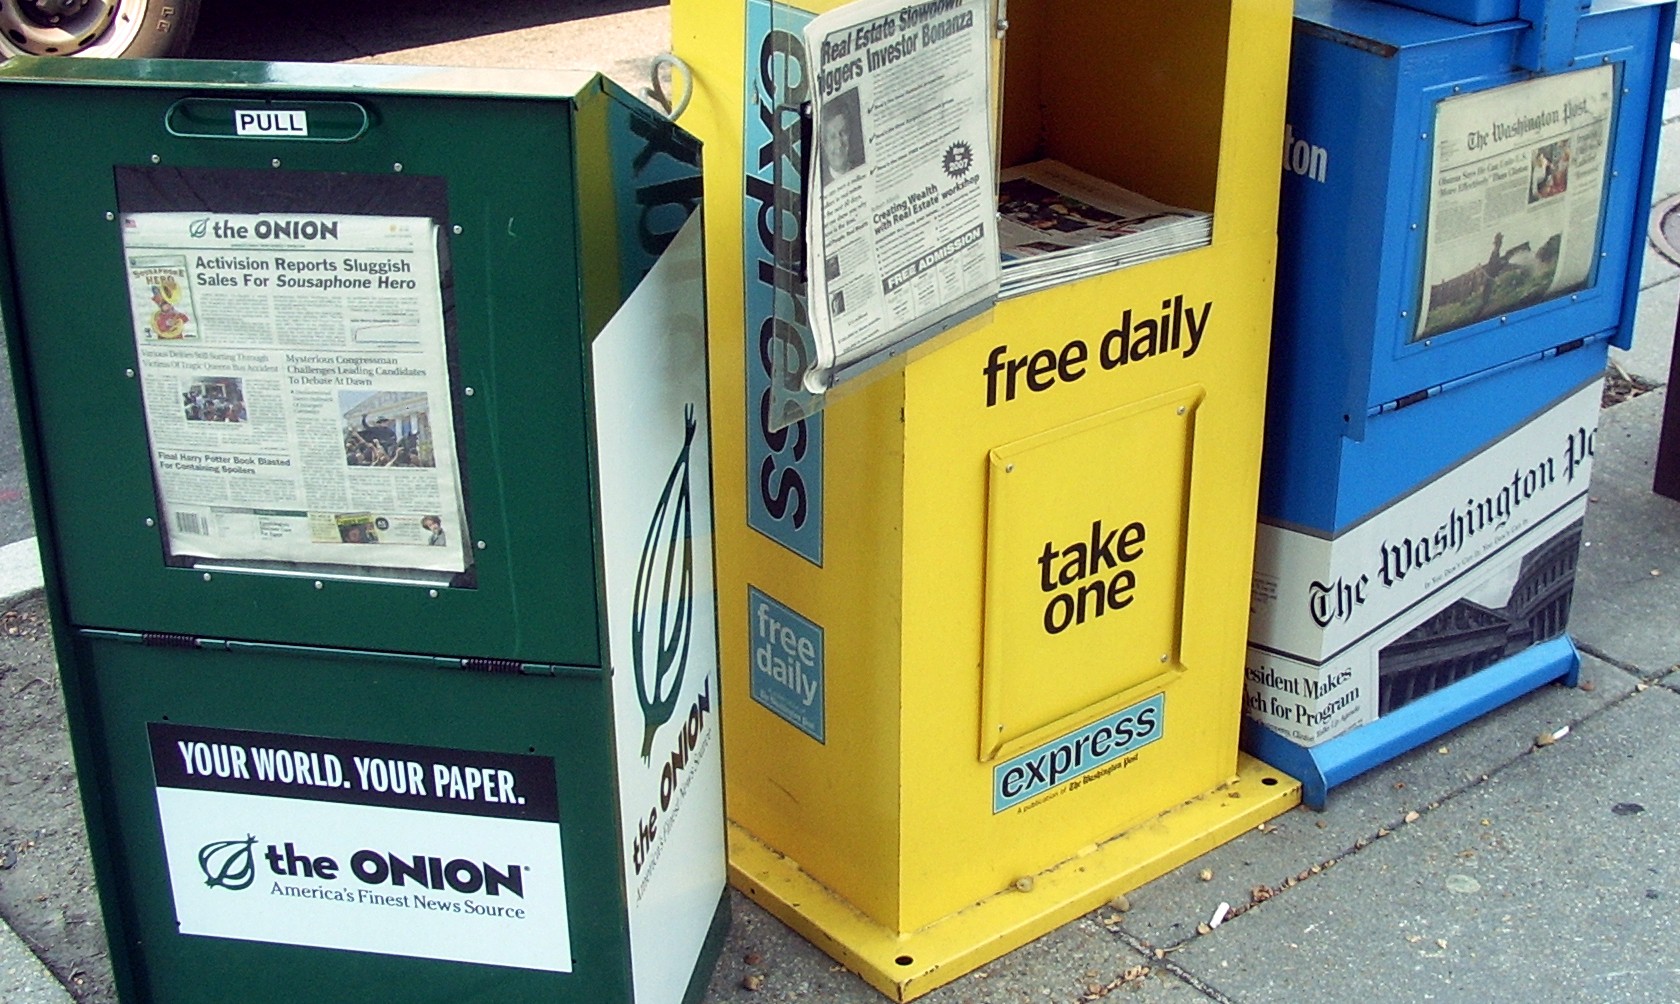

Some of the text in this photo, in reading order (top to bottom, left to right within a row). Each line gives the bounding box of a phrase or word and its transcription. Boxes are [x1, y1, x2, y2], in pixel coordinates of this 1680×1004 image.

[821, 32, 851, 66] Real
[855, 16, 895, 51] Estate
[867, 32, 918, 73] Investor
[922, 10, 973, 48] Bonanza
[241, 113, 303, 132] PULL
[1467, 130, 1490, 151] The
[1493, 109, 1559, 143] Washington
[213, 220, 338, 240] the ONION
[873, 199, 908, 224] Creating
[908, 183, 938, 208] Wealth
[874, 218, 892, 236] with
[892, 209, 911, 229] Real
[913, 197, 939, 220] Estate
[941, 174, 980, 200] workshop
[196, 256, 411, 275] Activision Reports Sluggish
[197, 273, 416, 290] Sales For Sousaphone Hero
[887, 266, 917, 289] FREE
[918, 228, 982, 273] ADMISSION
[287, 365, 336, 376] Challenges
[336, 356, 398, 366] Congressman
[982, 294, 1213, 408] free daily
[289, 376, 299, 384] To
[1037, 519, 1146, 592] take
[1309, 573, 1369, 628] The
[1377, 456, 1555, 588] Washington
[1044, 569, 1136, 635] one
[757, 603, 815, 667] free
[756, 643, 818, 706] daily
[1303, 667, 1352, 700] Makes
[1270, 697, 1292, 720] for
[1295, 687, 1360, 728] Program
[178, 740, 526, 805] YOUR WORLD. YOUR PAPER.
[633, 806, 658, 876] the
[660, 674, 711, 812] ONION
[1002, 707, 1155, 798] express
[265, 842, 525, 900] the ONION
[270, 881, 526, 919] America's Finest News Source
